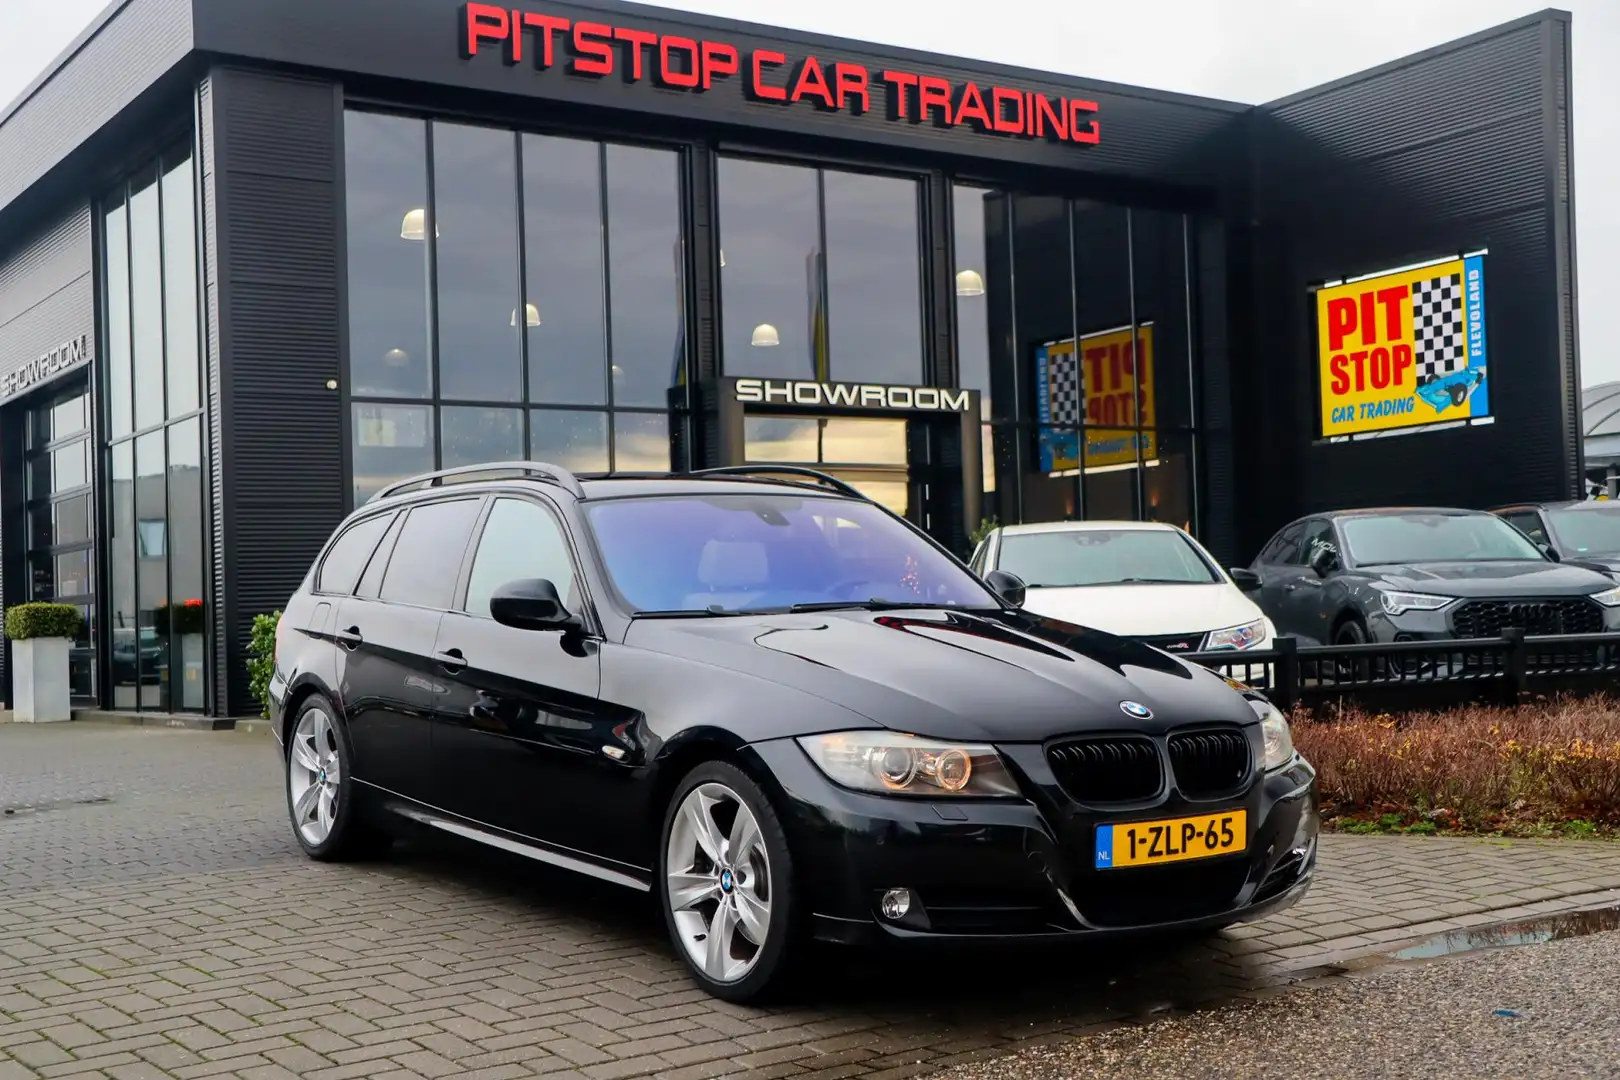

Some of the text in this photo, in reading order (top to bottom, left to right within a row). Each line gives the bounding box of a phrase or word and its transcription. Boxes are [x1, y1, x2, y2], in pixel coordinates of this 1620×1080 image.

[465, 2, 1100, 144] PITSTOP CAR TRADING
[1327, 285, 1409, 352] PIT
[1468, 269, 1482, 357] FLEVOLAND
[1330, 344, 1412, 395] STOP
[735, 379, 970, 411] SHOWROOM
[1331, 396, 1415, 423] CAR TRADING
[1098, 851, 1110, 860] NL
[1127, 817, 1234, 860] 1-ZLP-65
